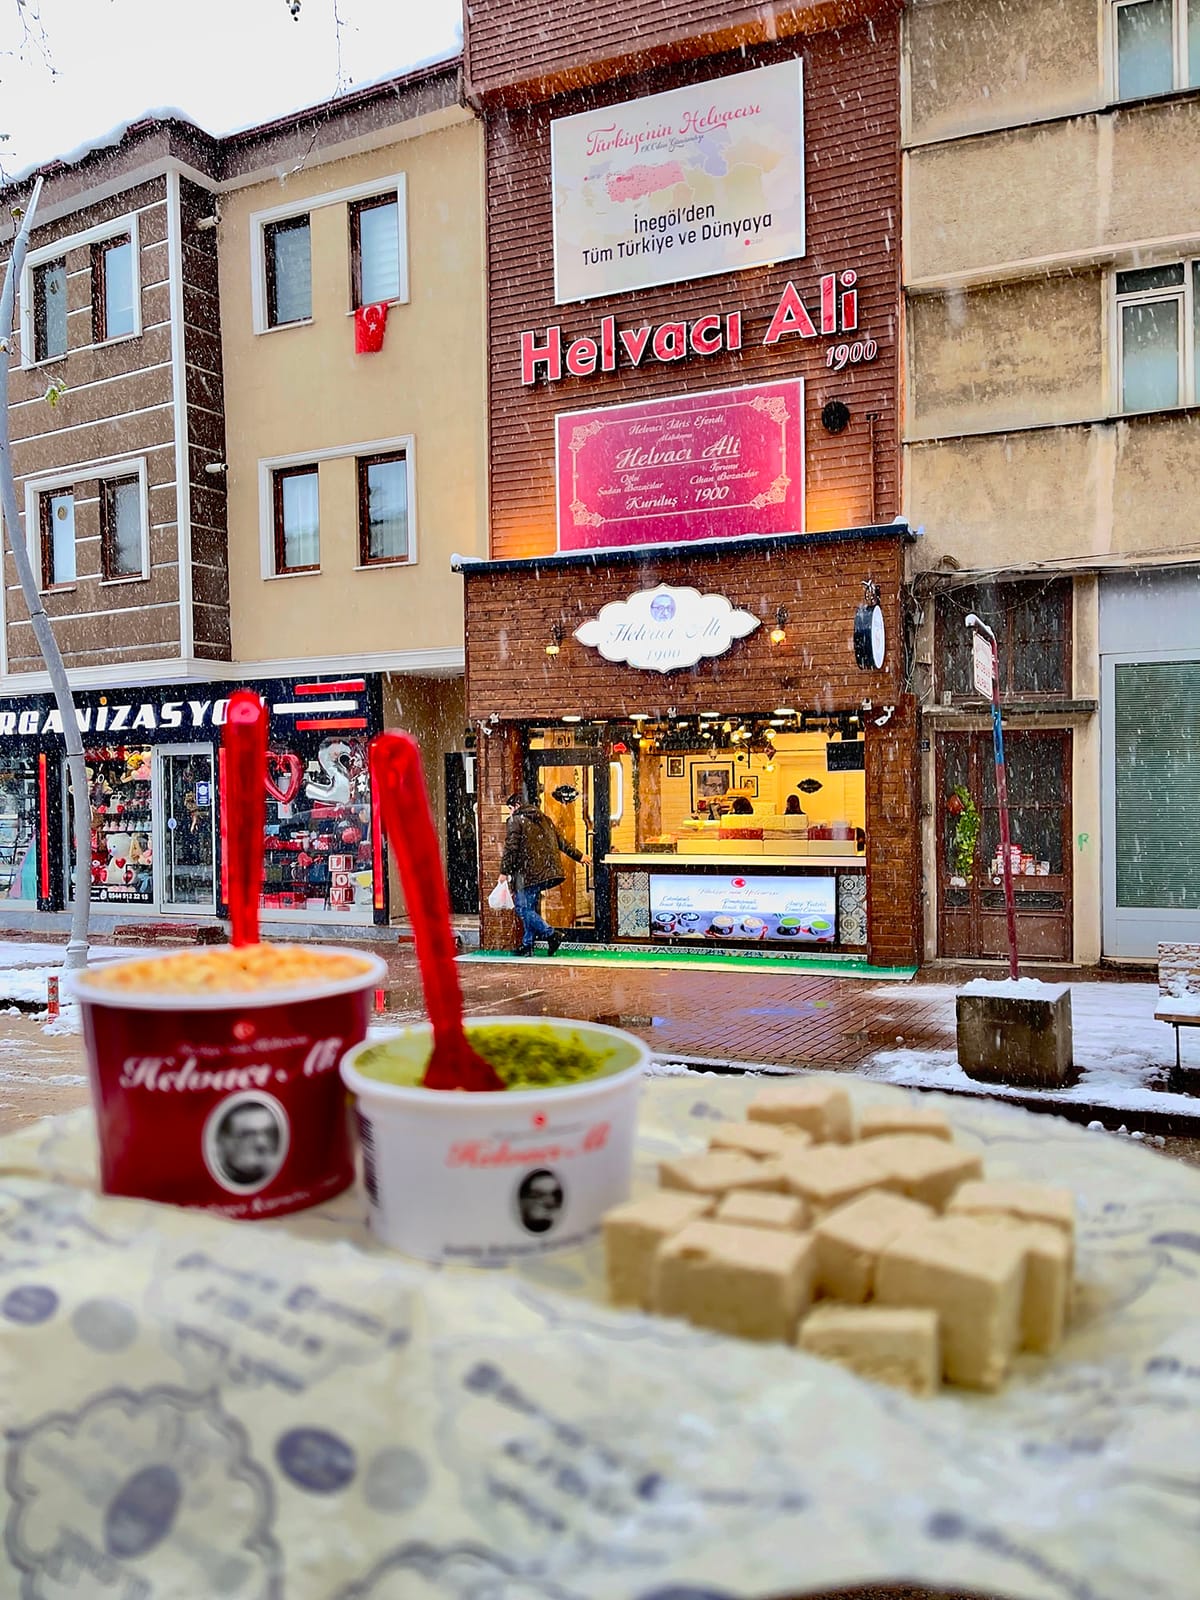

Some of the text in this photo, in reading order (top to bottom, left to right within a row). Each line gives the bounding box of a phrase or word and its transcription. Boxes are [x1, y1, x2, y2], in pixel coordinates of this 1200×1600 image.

[679, 104, 761, 134] Helvacısı
[634, 205, 715, 233] İnegöl'den
[582, 213, 772, 265] Tüm Türkiye ve Dünyaya
[520, 311, 742, 386] Helvacı
[825, 340, 877, 371] 1900
[616, 434, 740, 469] Helvacı Ali
[695, 486, 730, 502] 1900
